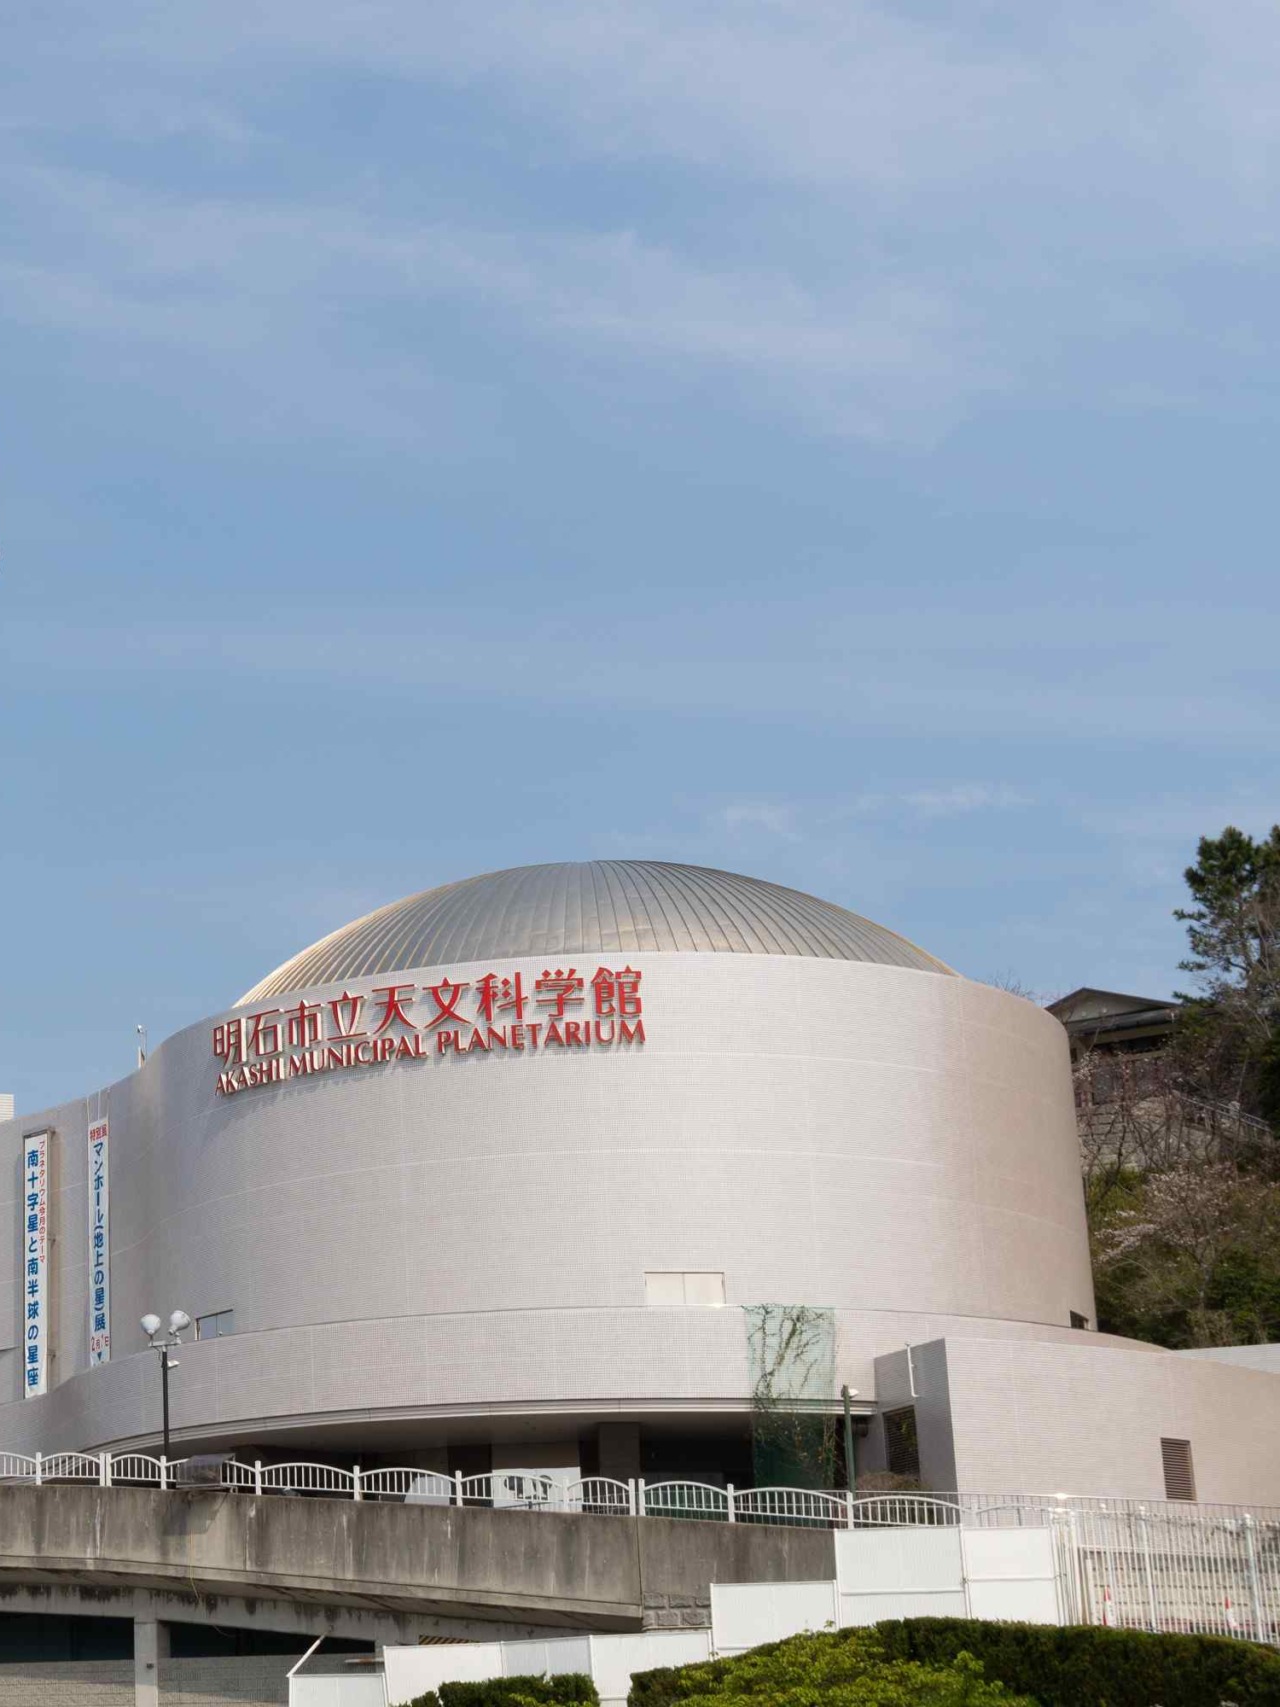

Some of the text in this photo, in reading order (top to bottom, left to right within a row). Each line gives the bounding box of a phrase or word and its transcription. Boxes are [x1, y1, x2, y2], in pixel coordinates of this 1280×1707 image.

[212, 964, 643, 1066] 明石市立天文科学館
[214, 1018, 646, 1097] AKASHI MUNICIPAL PLANETARIUM
[27, 1148, 39, 1387] 南十字星と南半球の星座
